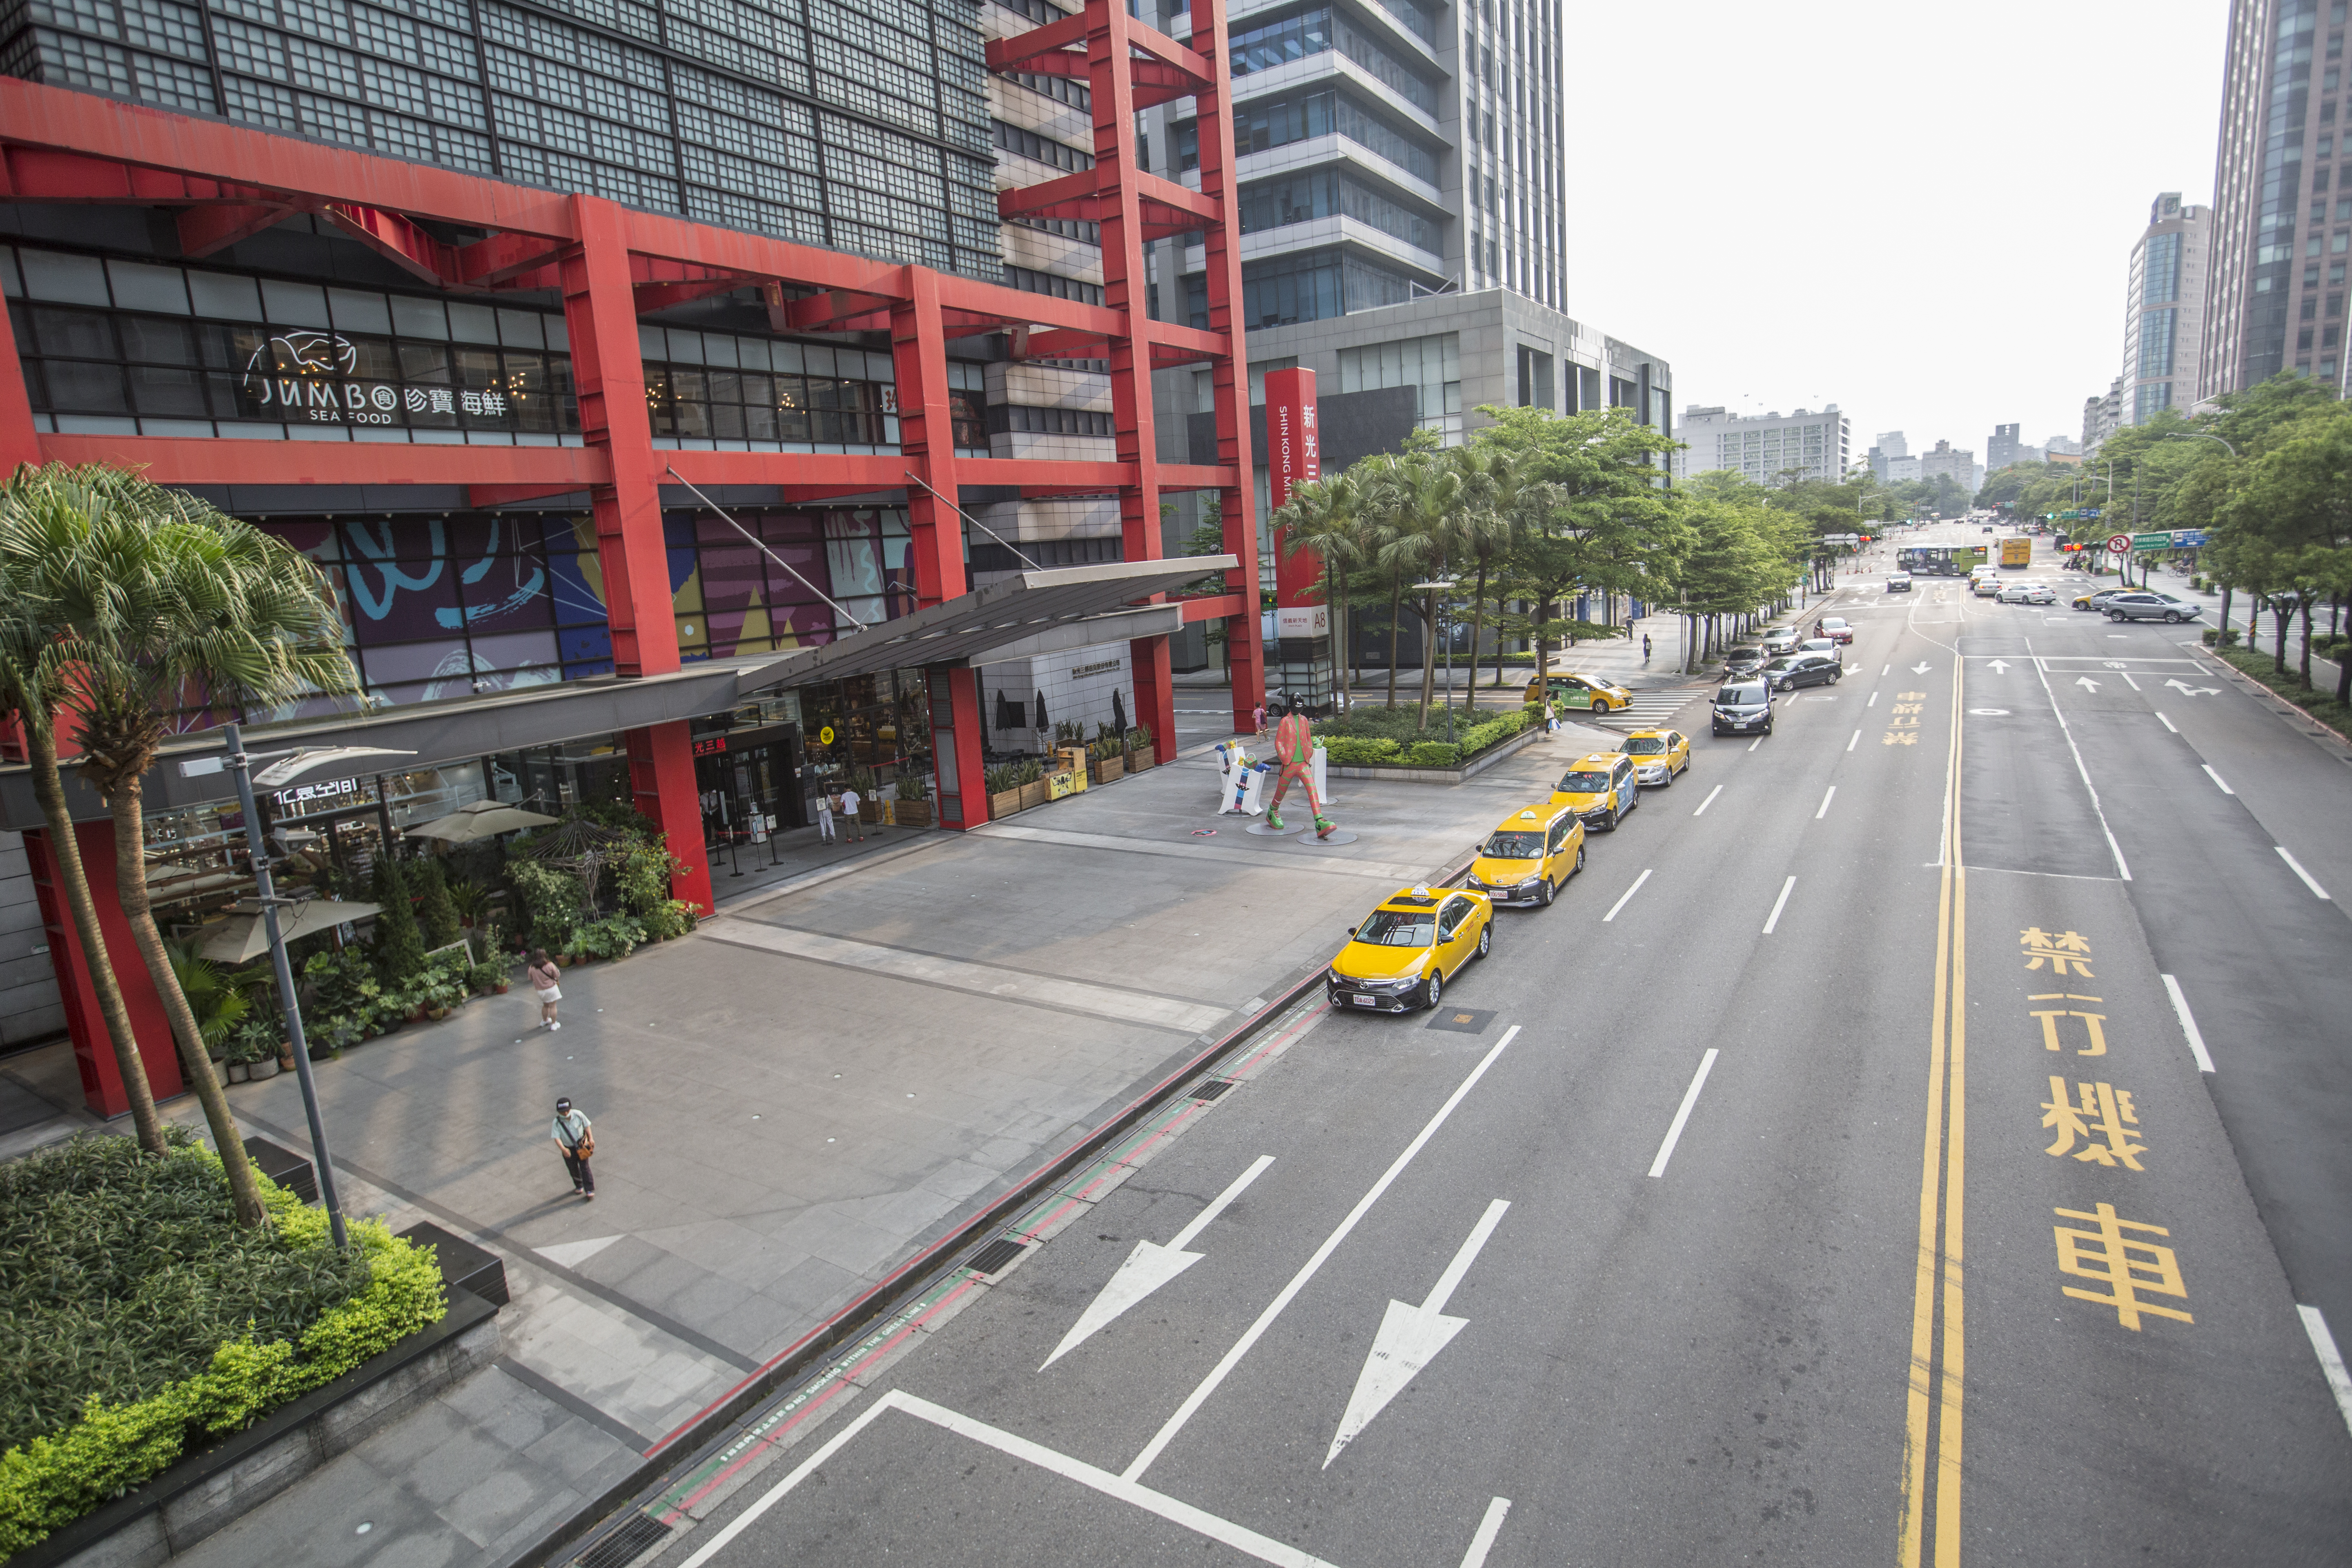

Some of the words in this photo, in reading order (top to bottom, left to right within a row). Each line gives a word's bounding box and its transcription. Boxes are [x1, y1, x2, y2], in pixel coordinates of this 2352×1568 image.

[310, 410, 341, 421] SEA
[1279, 406, 1288, 436] SHIN
[1281, 438, 1291, 473] KONG
[1314, 612, 1325, 629] A8
[695, 737, 726, 753] 光三越
[2020, 927, 2194, 1331] 禁行機車
[793, 1394, 806, 1405] NO
[806, 1368, 842, 1394] SMOKING
[840, 1347, 868, 1367] WITHIN
[866, 1335, 882, 1347] THE
[882, 1318, 906, 1335] GREEN
[904, 1306, 922, 1319] LINE
